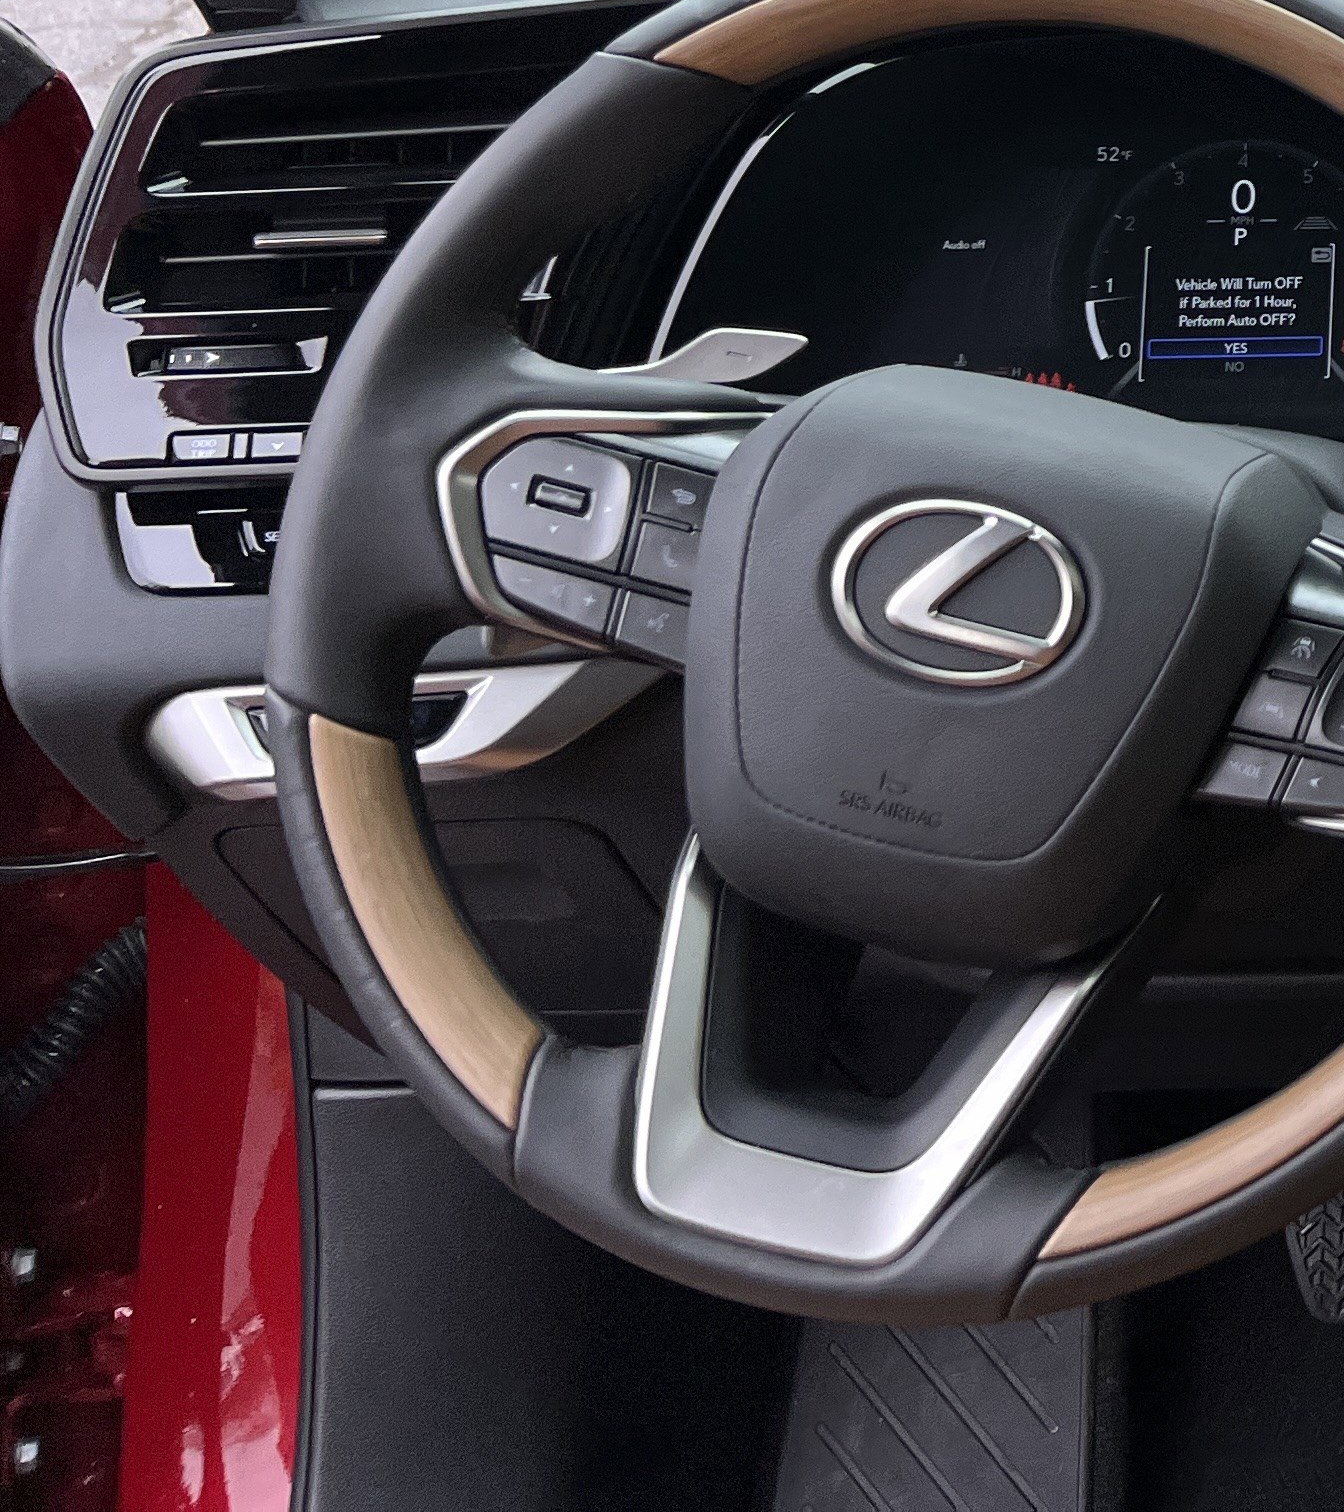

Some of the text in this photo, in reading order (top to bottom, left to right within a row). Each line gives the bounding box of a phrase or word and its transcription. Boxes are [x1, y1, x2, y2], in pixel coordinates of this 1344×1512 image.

[1238, 154, 1248, 168] 4
[1174, 172, 1185, 186] 3
[1303, 170, 1314, 184] 5
[1231, 179, 1256, 214] 0
[1124, 217, 1136, 231] 2
[1230, 217, 1254, 226] MPH
[1233, 228, 1248, 245] P
[942, 240, 986, 250] Audio off
[1106, 278, 1114, 293] 1
[1175, 276, 1303, 291] Vehicle Will Turn OFF
[1179, 295, 1297, 310] if Parked for 1 Hour,
[1178, 312, 1296, 328] Perform Auto OFF?
[1118, 342, 1132, 358] 0
[1224, 342, 1248, 354] YES
[1225, 361, 1245, 373] NO
